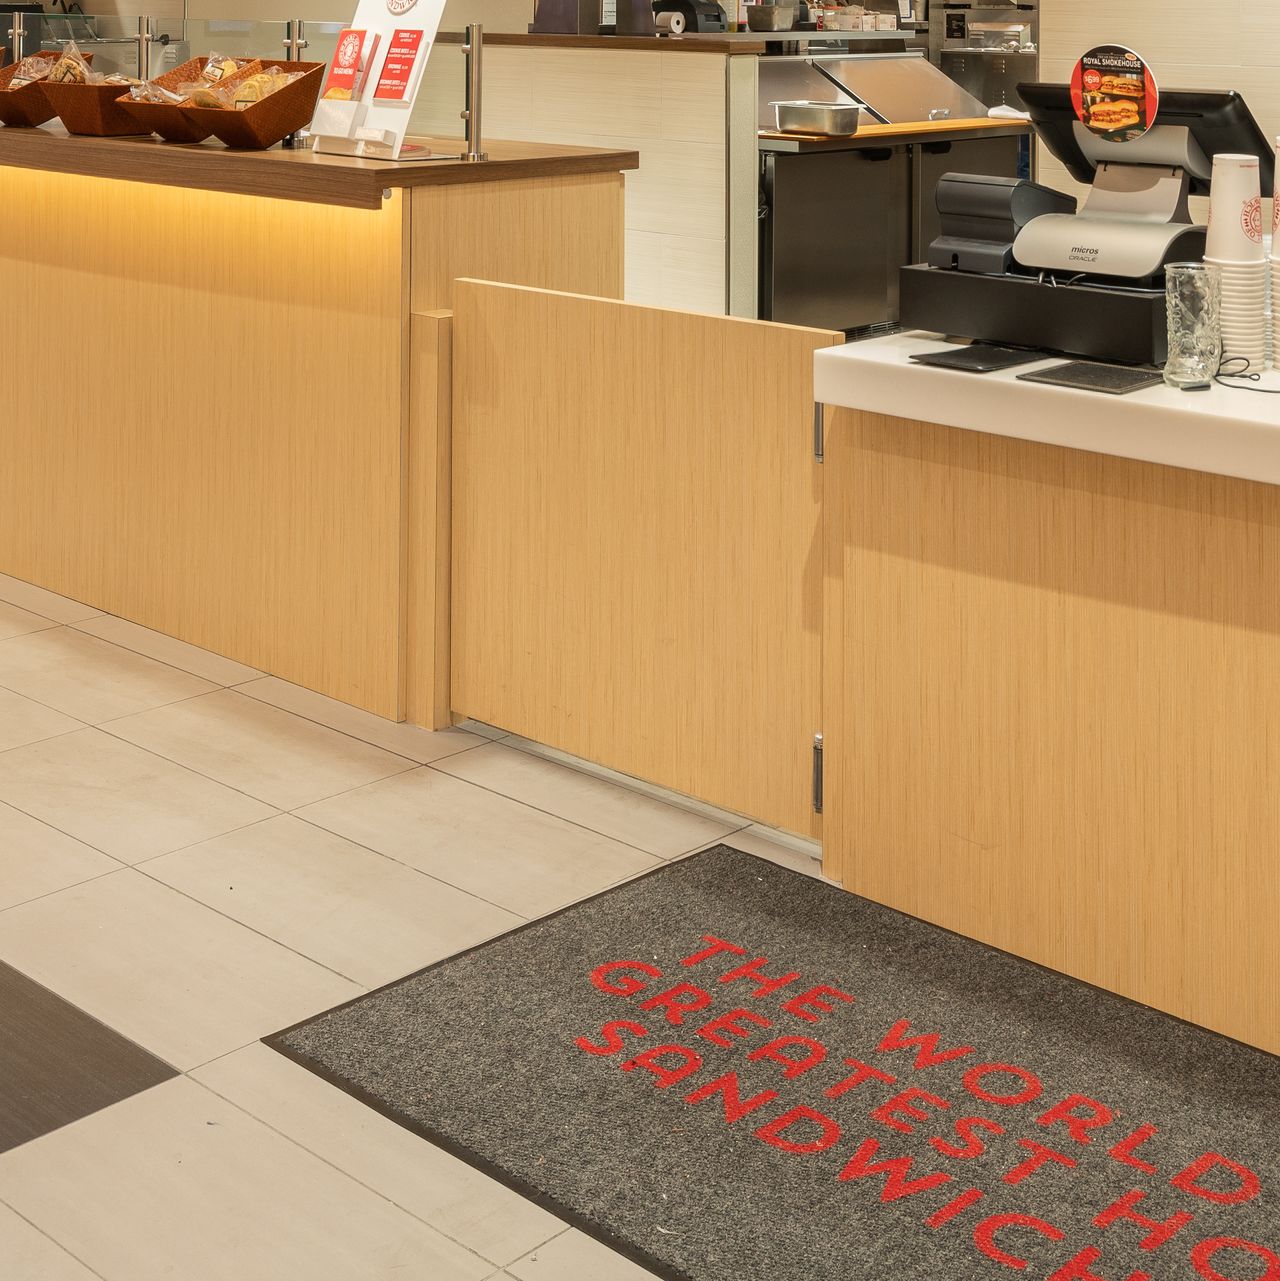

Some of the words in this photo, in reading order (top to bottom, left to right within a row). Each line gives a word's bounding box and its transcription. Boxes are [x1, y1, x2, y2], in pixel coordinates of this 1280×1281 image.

[1083, 57, 1101, 65] ROYAL
[1102, 59, 1142, 68] SMOKEHOUSE
[1071, 245, 1099, 255] micros
[1068, 255, 1097, 263] ORACLE
[680, 935, 856, 1022] THE
[588, 959, 1078, 1185] GREATEST
